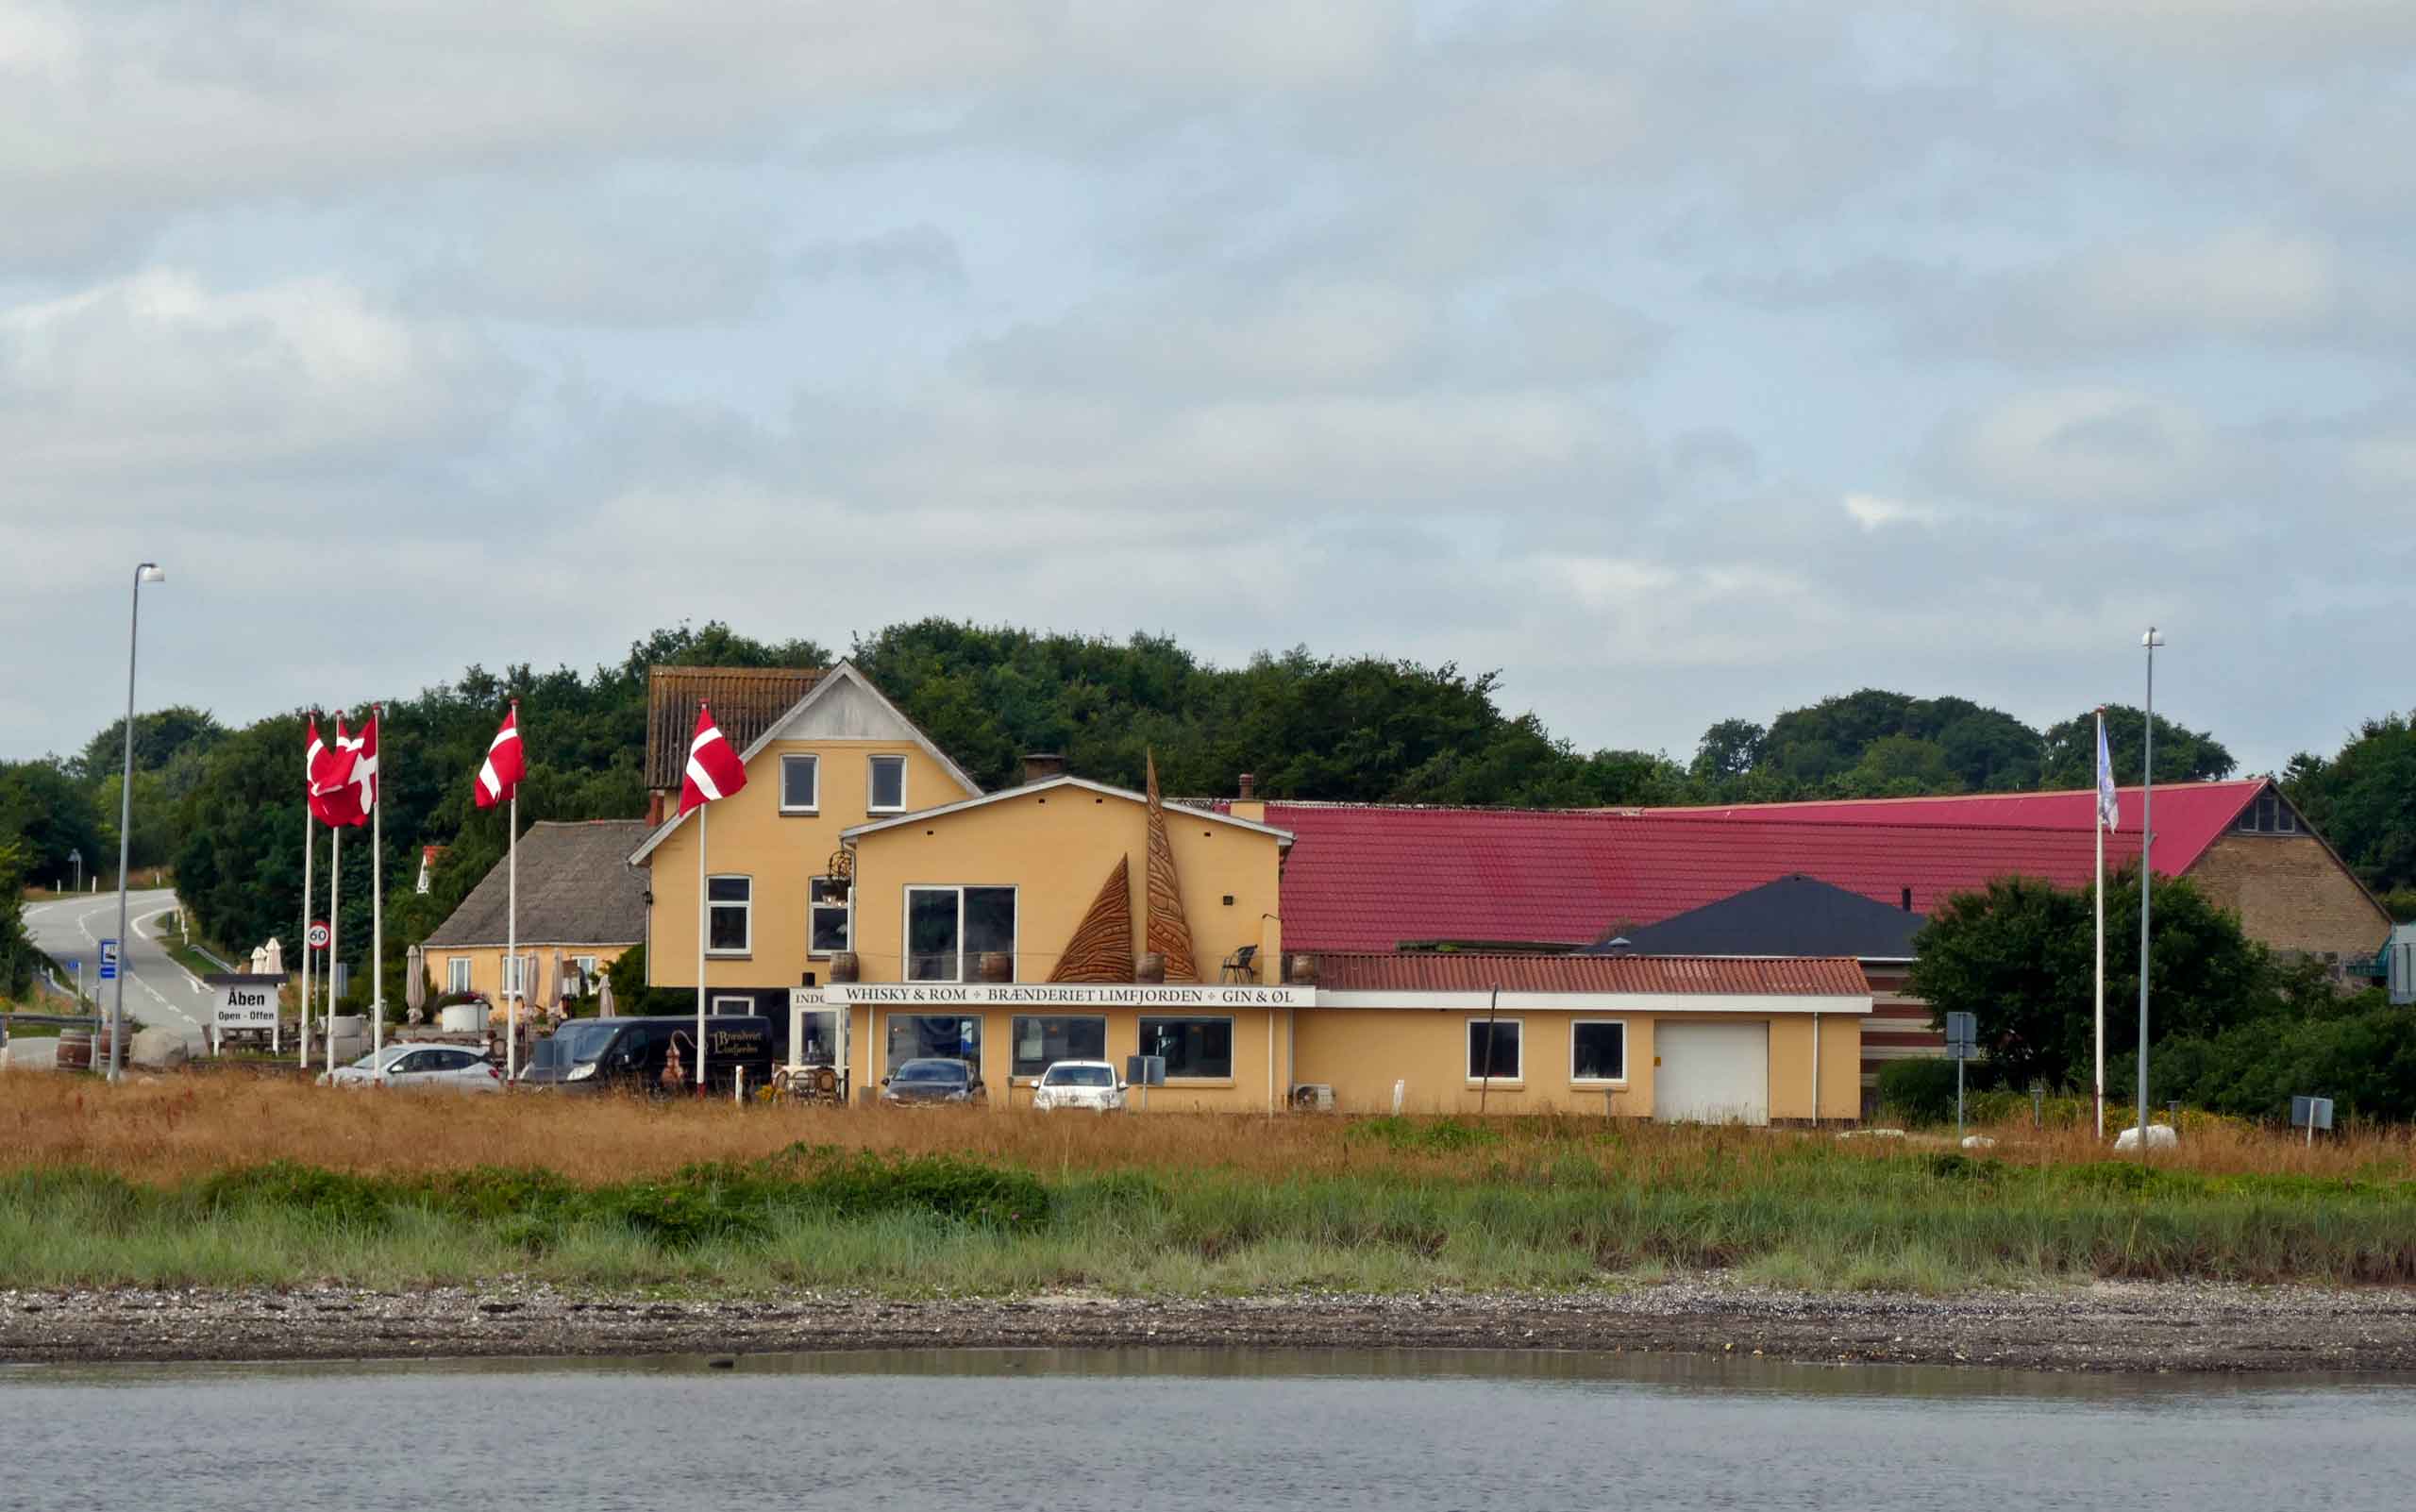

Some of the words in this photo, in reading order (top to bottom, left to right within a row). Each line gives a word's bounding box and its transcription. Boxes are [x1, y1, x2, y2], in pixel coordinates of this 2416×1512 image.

[310, 930, 327, 942] 60
[227, 986, 265, 1006] Åben
[847, 988, 909, 1001] WHISKY
[914, 988, 925, 1001] &
[930, 988, 966, 1001] ROM
[988, 988, 1095, 1002] BRÆNDERIET
[1099, 989, 1203, 1004] LIMFJORDEN
[1222, 989, 1252, 1002] GIN
[1256, 989, 1267, 1002] &
[1271, 989, 1294, 1003] ØL
[218, 1011, 241, 1021] Open
[249, 1011, 275, 1020] Offen
